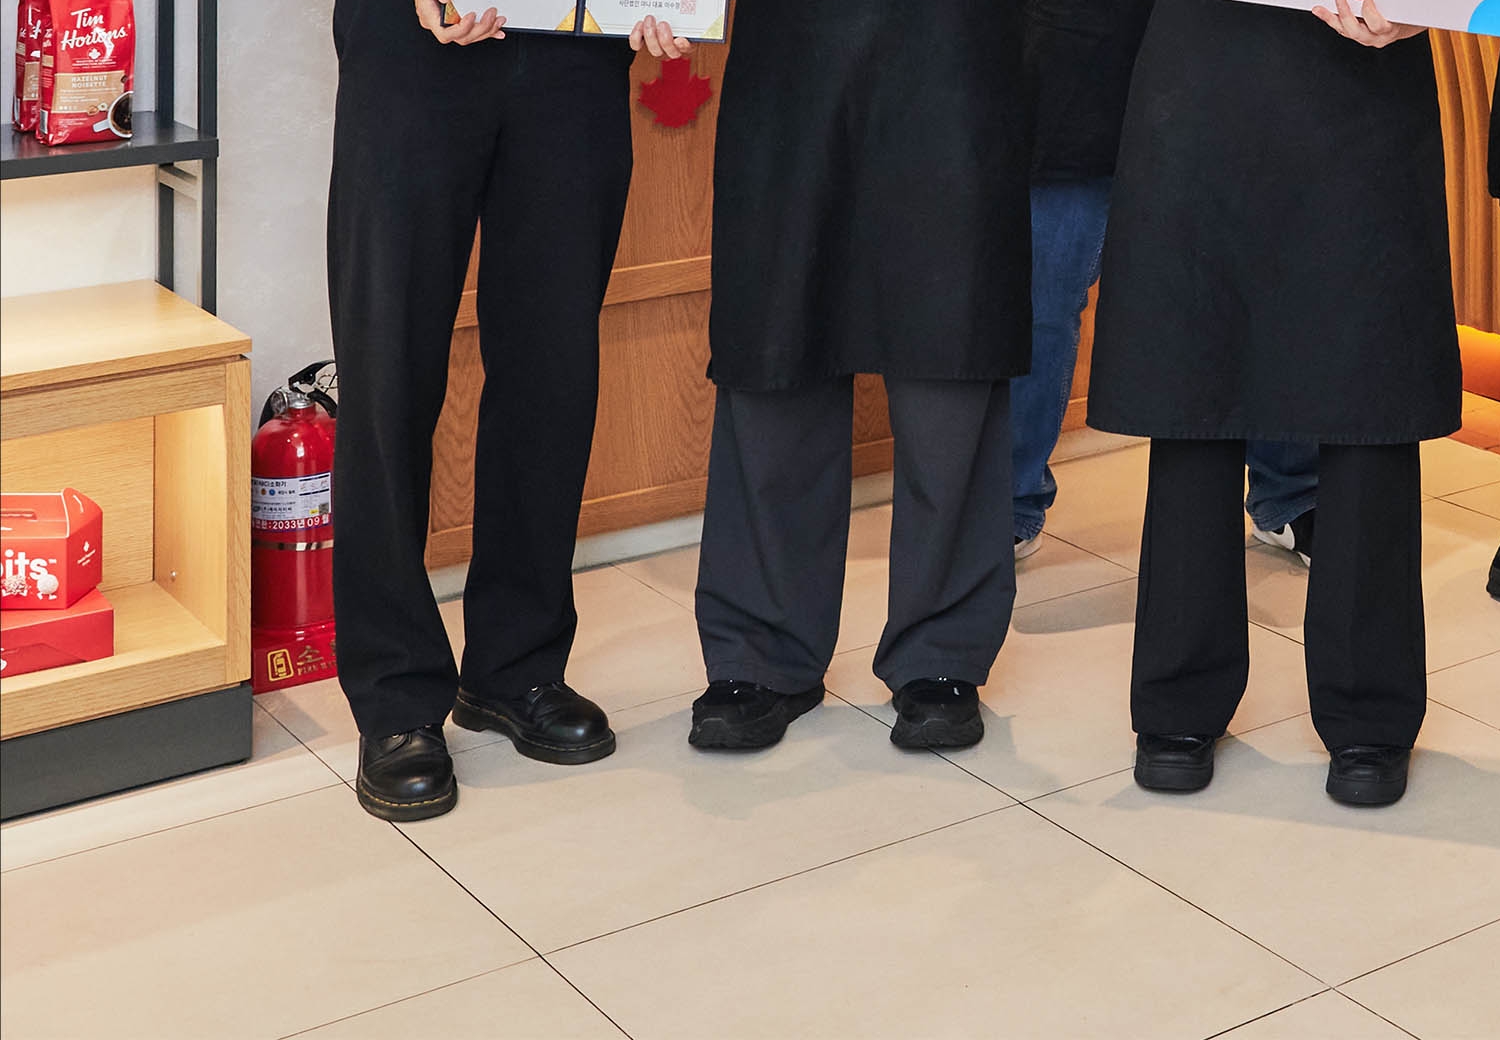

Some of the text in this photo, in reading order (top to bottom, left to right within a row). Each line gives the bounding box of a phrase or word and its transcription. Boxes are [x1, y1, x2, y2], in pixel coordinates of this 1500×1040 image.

[70, 7, 104, 29] Tim
[60, 26, 127, 51] Hortons
[307, 517, 320, 526] 09
[0, 549, 48, 581] its
